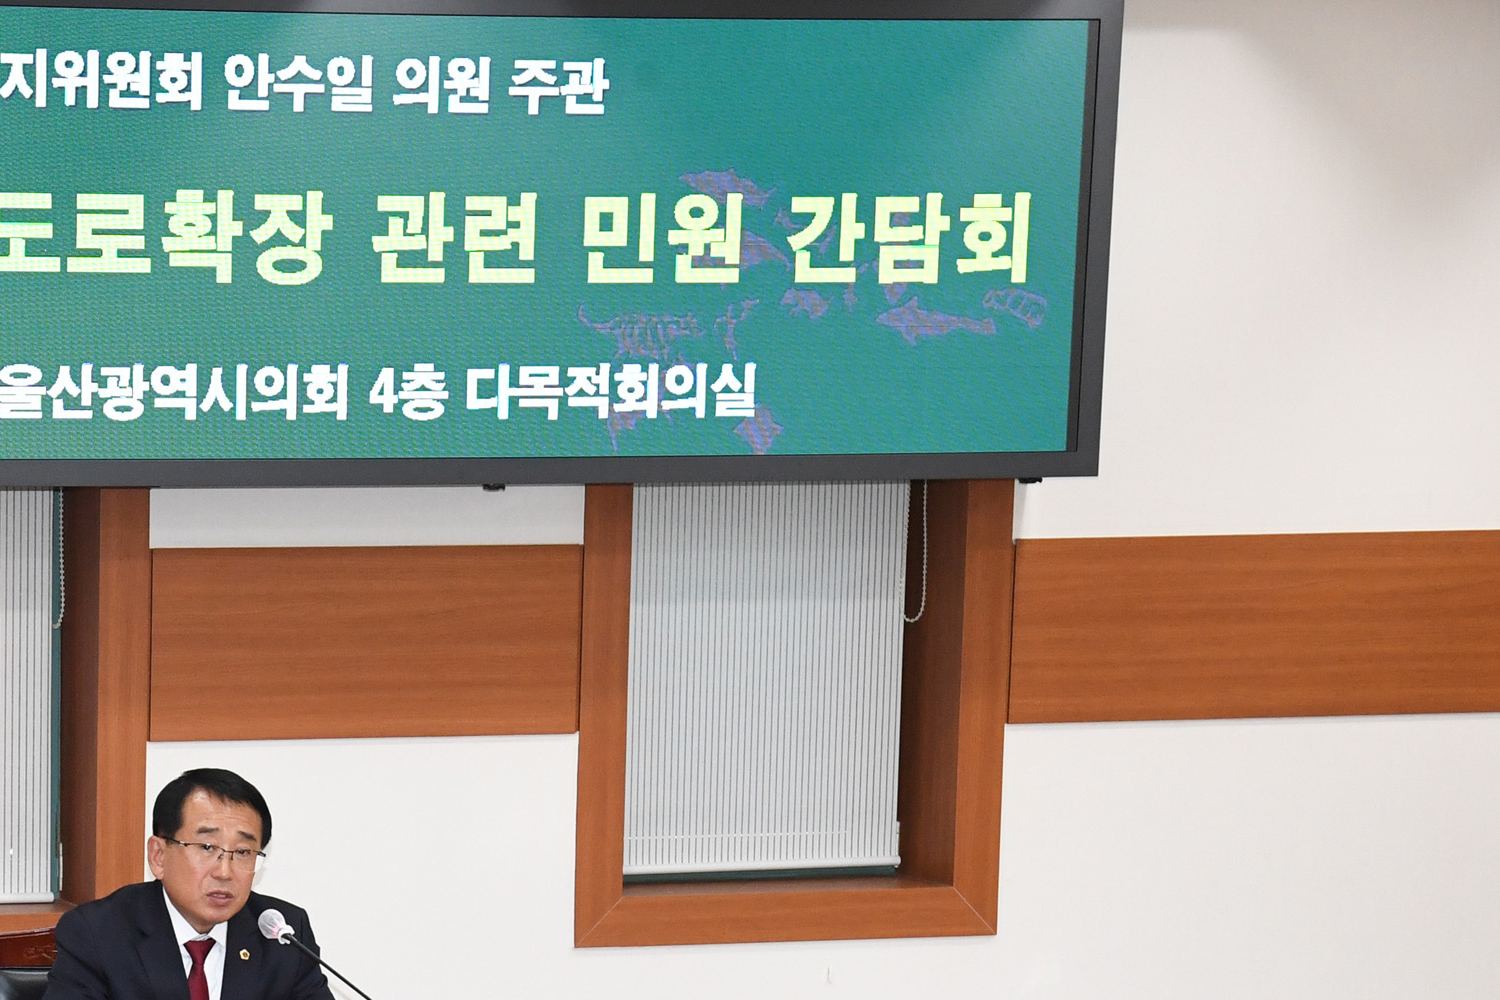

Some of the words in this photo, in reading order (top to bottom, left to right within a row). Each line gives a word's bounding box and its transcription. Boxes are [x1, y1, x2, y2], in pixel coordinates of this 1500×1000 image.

[225, 53, 374, 113] 안수일
[393, 55, 491, 114] 의원
[508, 57, 610, 116] 주관
[371, 191, 538, 284] 관련
[583, 192, 744, 284] 민원
[786, 192, 1032, 285] 간담회
[369, 363, 449, 421] 4층
[466, 362, 757, 421] 다목적회의실
